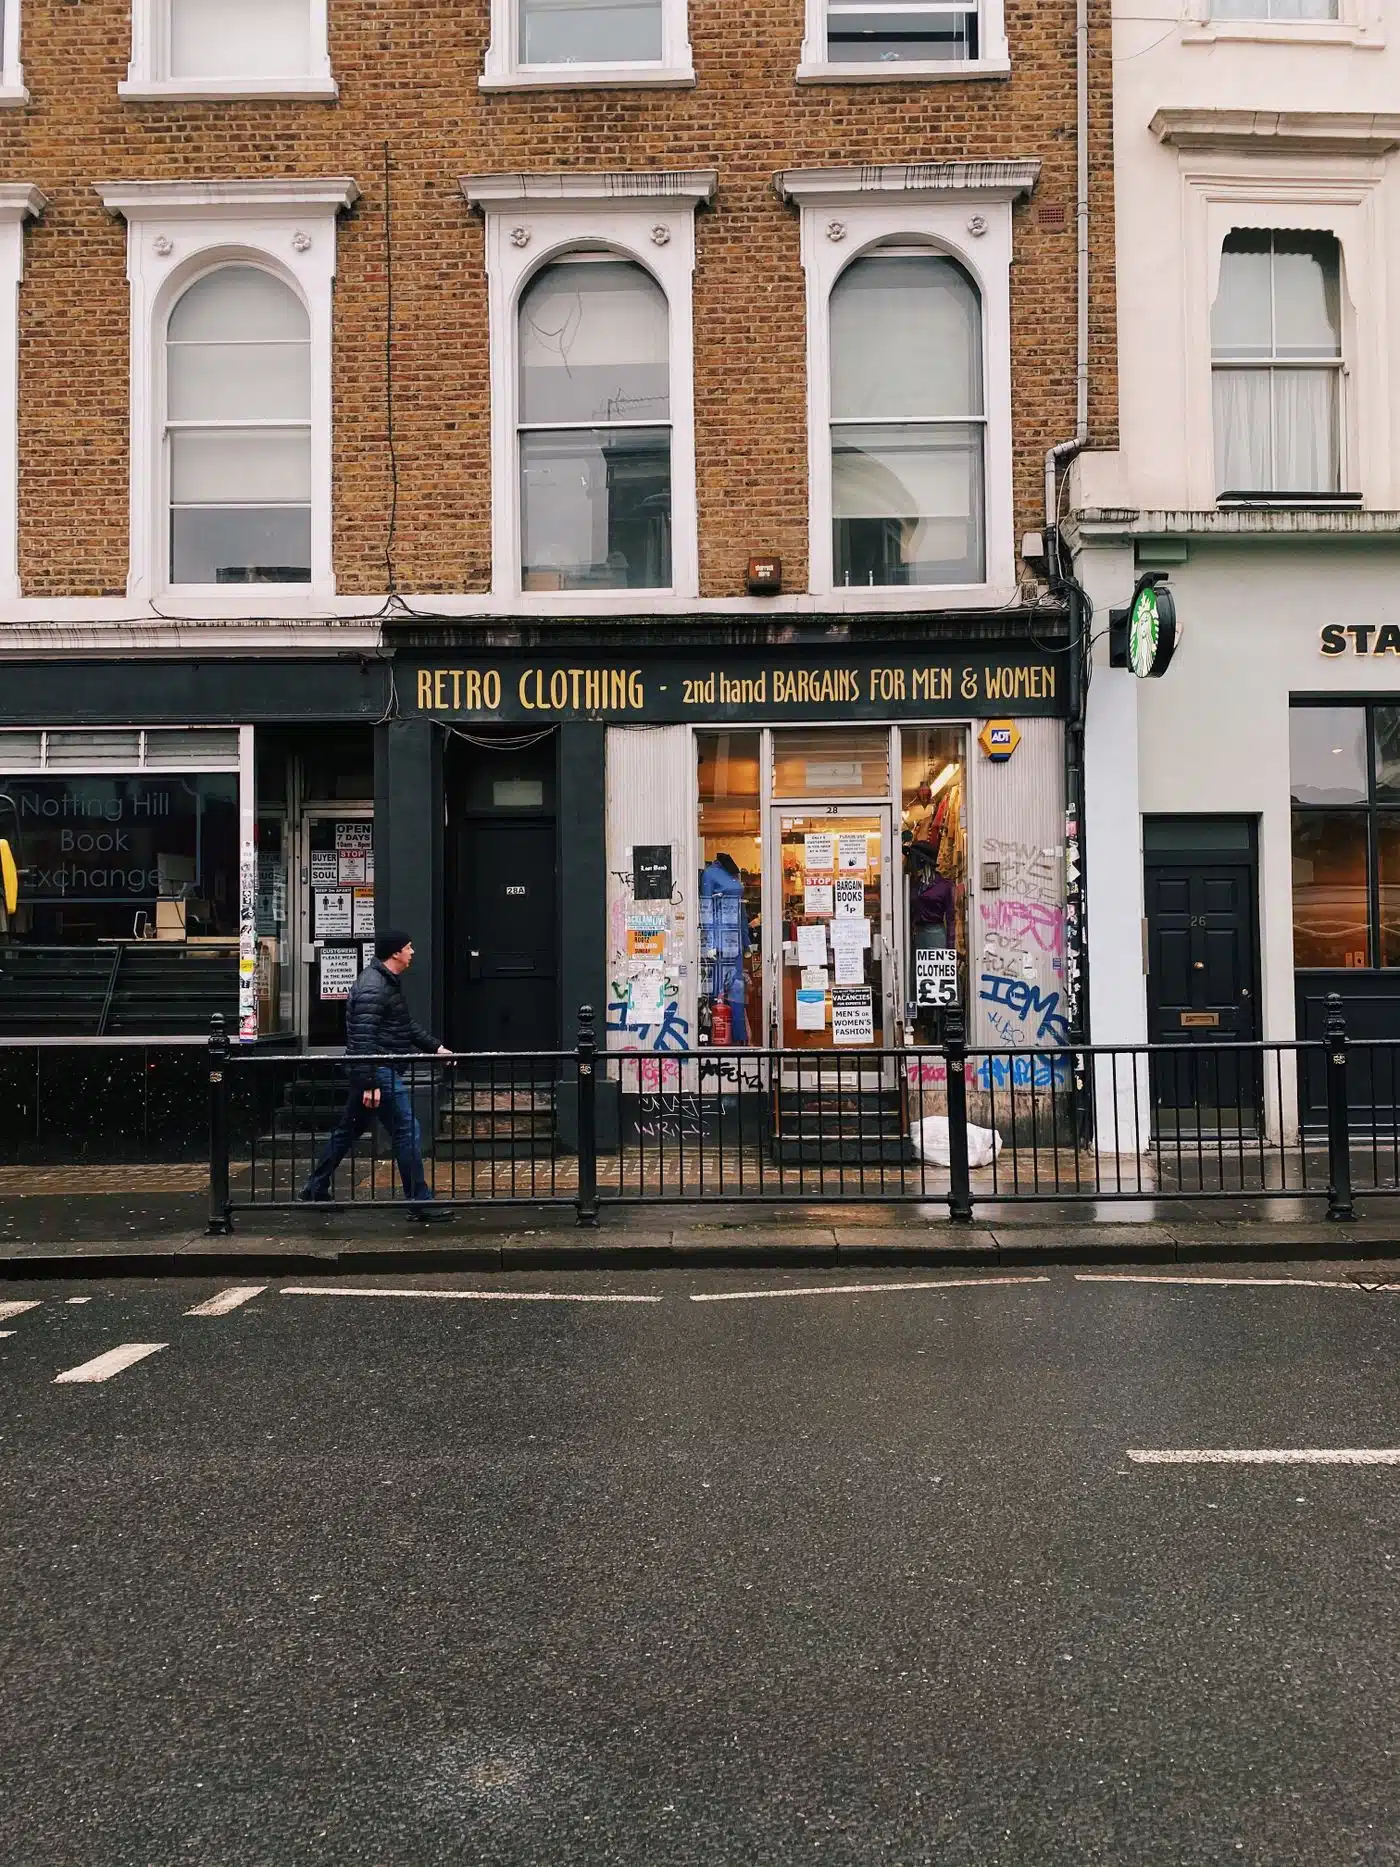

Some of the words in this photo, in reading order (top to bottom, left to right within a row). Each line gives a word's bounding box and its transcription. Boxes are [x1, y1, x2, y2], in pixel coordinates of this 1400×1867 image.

[417, 669, 501, 709] RETRO
[518, 669, 644, 709] CLOTHING
[682, 671, 715, 704] 2nd
[719, 670, 766, 704] hand
[772, 669, 860, 702] BARGAINS
[869, 668, 906, 700] FOR
[912, 668, 952, 700] MEN
[960, 667, 978, 700] &
[985, 666, 1056, 699] WOMEN
[992, 731, 1010, 742] ADT
[20, 792, 123, 822] Notting
[133, 792, 169, 816] Hill
[825, 806, 838, 814] 28
[336, 824, 371, 834] OPEN
[60, 828, 130, 852] Book
[312, 853, 337, 862] BUYER
[340, 850, 364, 858] STOP
[23, 863, 165, 893] Exchange
[312, 871, 337, 879] SOUL
[806, 877, 831, 885] STOP
[836, 880, 863, 891] BARGAIN
[506, 886, 526, 895] 28A
[836, 891, 863, 902] BOOKS
[844, 903, 857, 914] 1p
[1190, 915, 1207, 927] 26
[917, 950, 956, 960] MEN'S
[917, 964, 956, 977] CLOTHES
[322, 986, 335, 994] BY
[918, 978, 957, 1004] £5
[832, 993, 871, 1001] VACANCIES
[835, 1010, 860, 1018] MEN'S
[834, 1018, 872, 1027] WOMEN'S
[835, 1028, 871, 1036] FASHION
